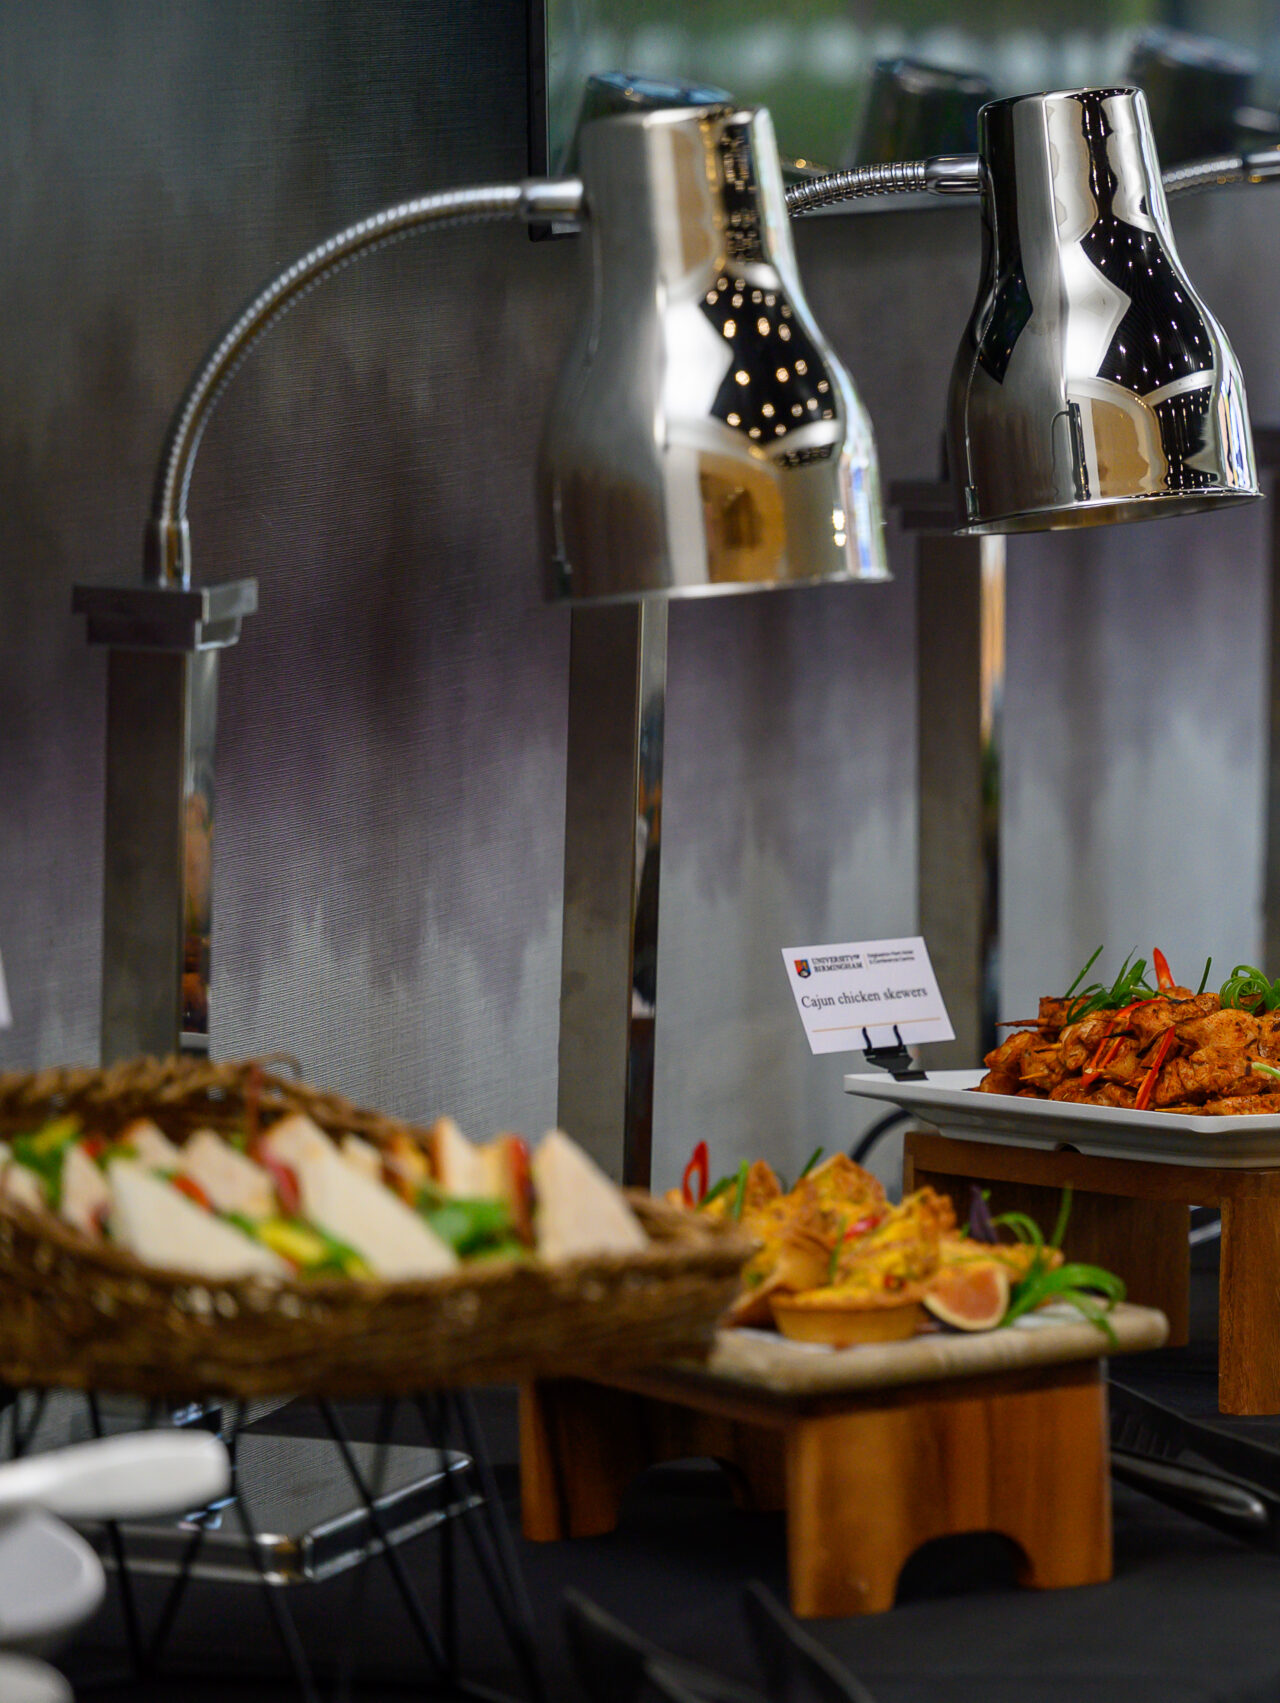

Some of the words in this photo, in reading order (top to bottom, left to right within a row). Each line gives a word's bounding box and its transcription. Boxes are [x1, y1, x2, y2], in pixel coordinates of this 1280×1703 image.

[811, 955, 853, 964] UNIVERSITY
[813, 961, 863, 972] BIRMINGHAM
[801, 994, 835, 1010] Cajun
[838, 990, 881, 1005] chicken
[883, 987, 928, 1000] skewers
